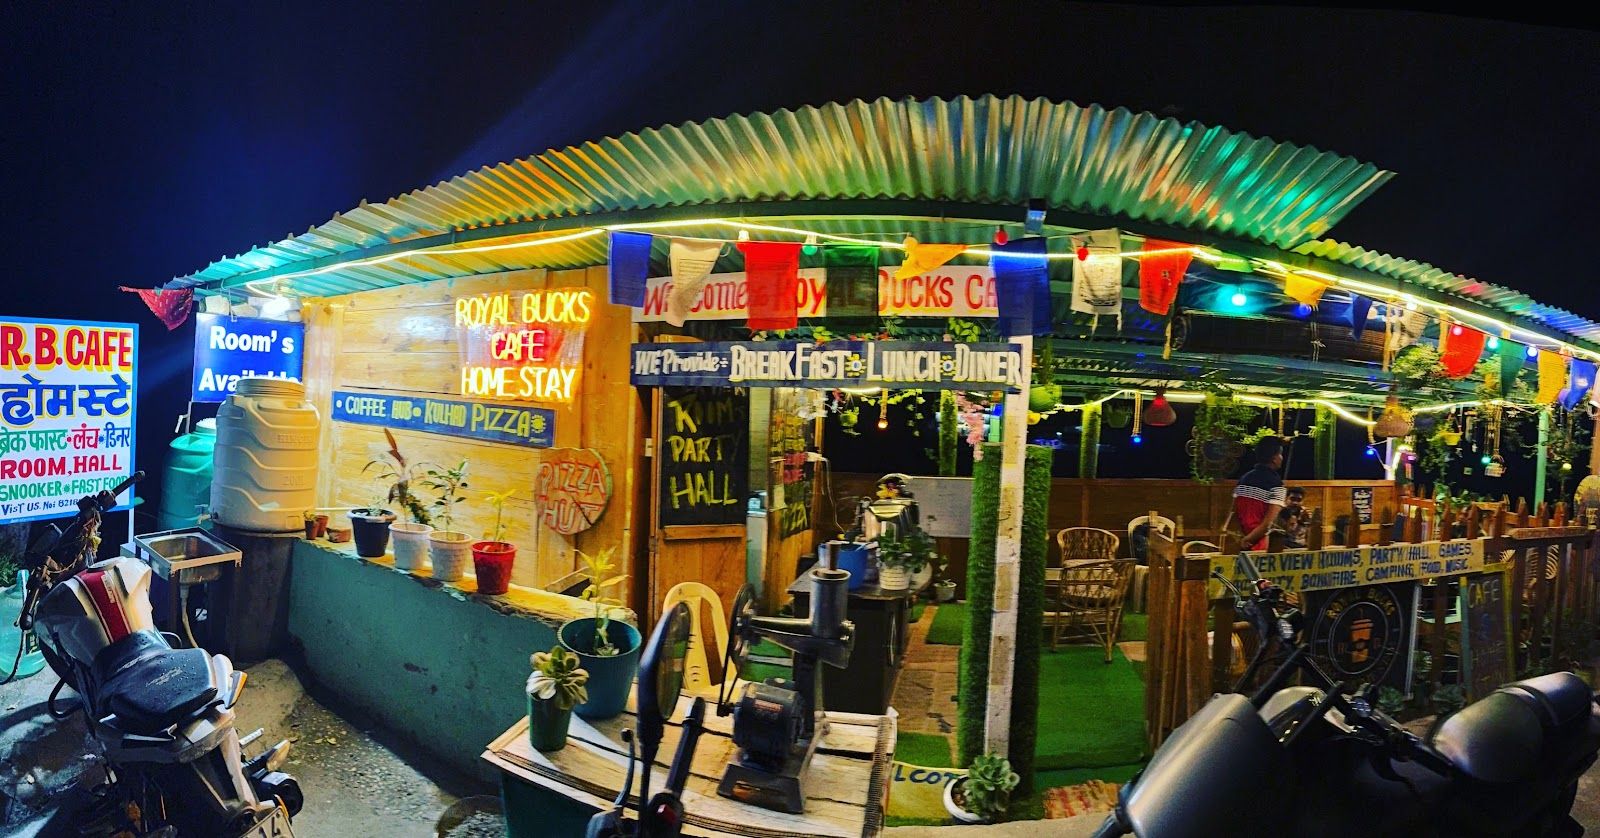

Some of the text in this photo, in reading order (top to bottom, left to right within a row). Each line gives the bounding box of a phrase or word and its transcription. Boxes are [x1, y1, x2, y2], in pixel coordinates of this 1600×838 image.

[456, 291, 592, 329] ROYAL BUCKS
[491, 330, 544, 362] CAFE
[461, 366, 576, 399] HOME STAY
[866, 342, 941, 382] LUNCH
[952, 343, 1022, 388] DINER
[345, 395, 387, 417] COFFEE
[470, 404, 532, 437] PIZZA
[539, 462, 606, 497] PIZZA
[669, 470, 738, 510] HALL
[1278, 550, 1314, 571] VIEW
